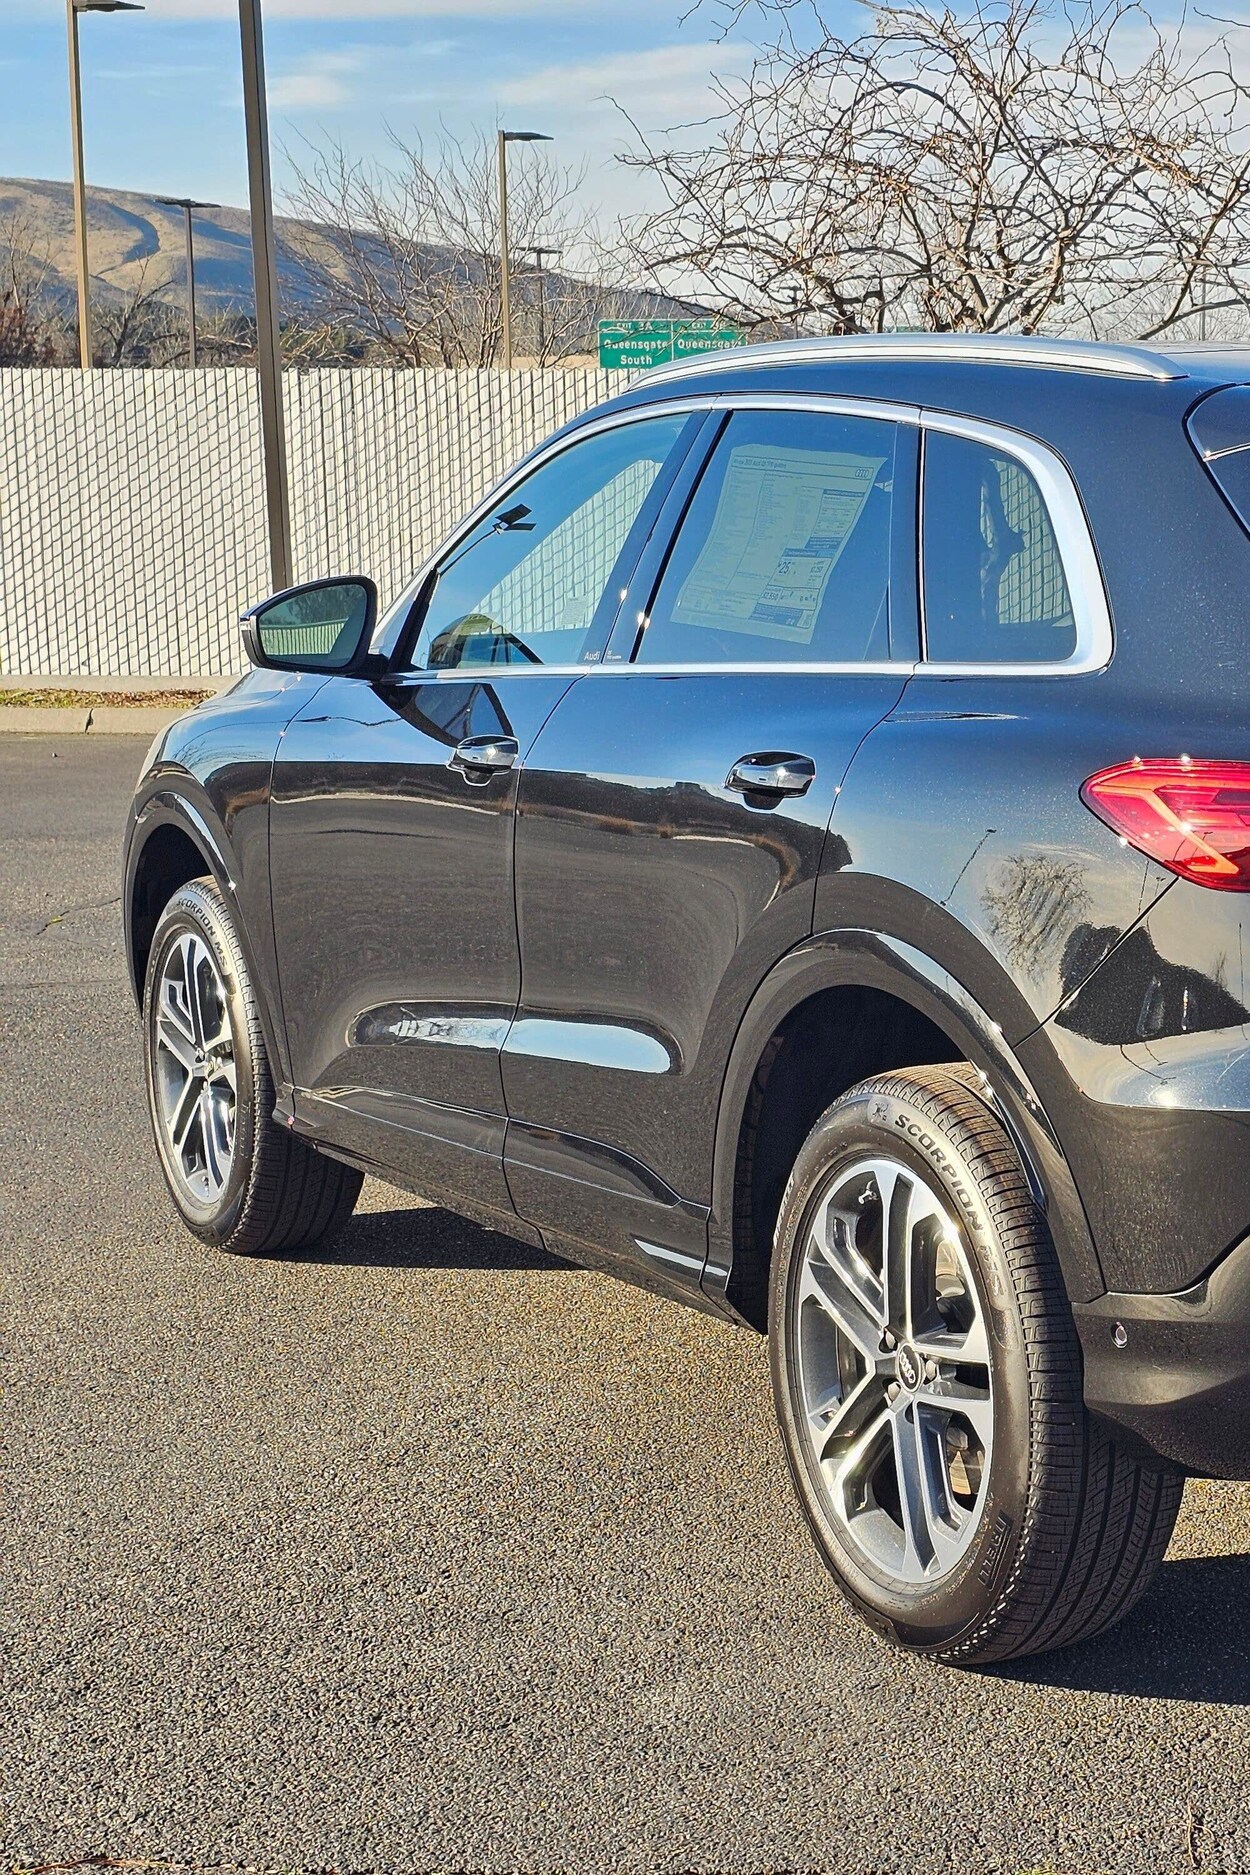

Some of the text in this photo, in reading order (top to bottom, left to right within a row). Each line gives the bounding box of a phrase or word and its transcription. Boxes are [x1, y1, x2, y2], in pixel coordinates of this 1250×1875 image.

[620, 354, 653, 365] South
[584, 651, 600, 661] Audi
[175, 897, 217, 938] SCORPION
[895, 1114, 984, 1231] SCORPION
